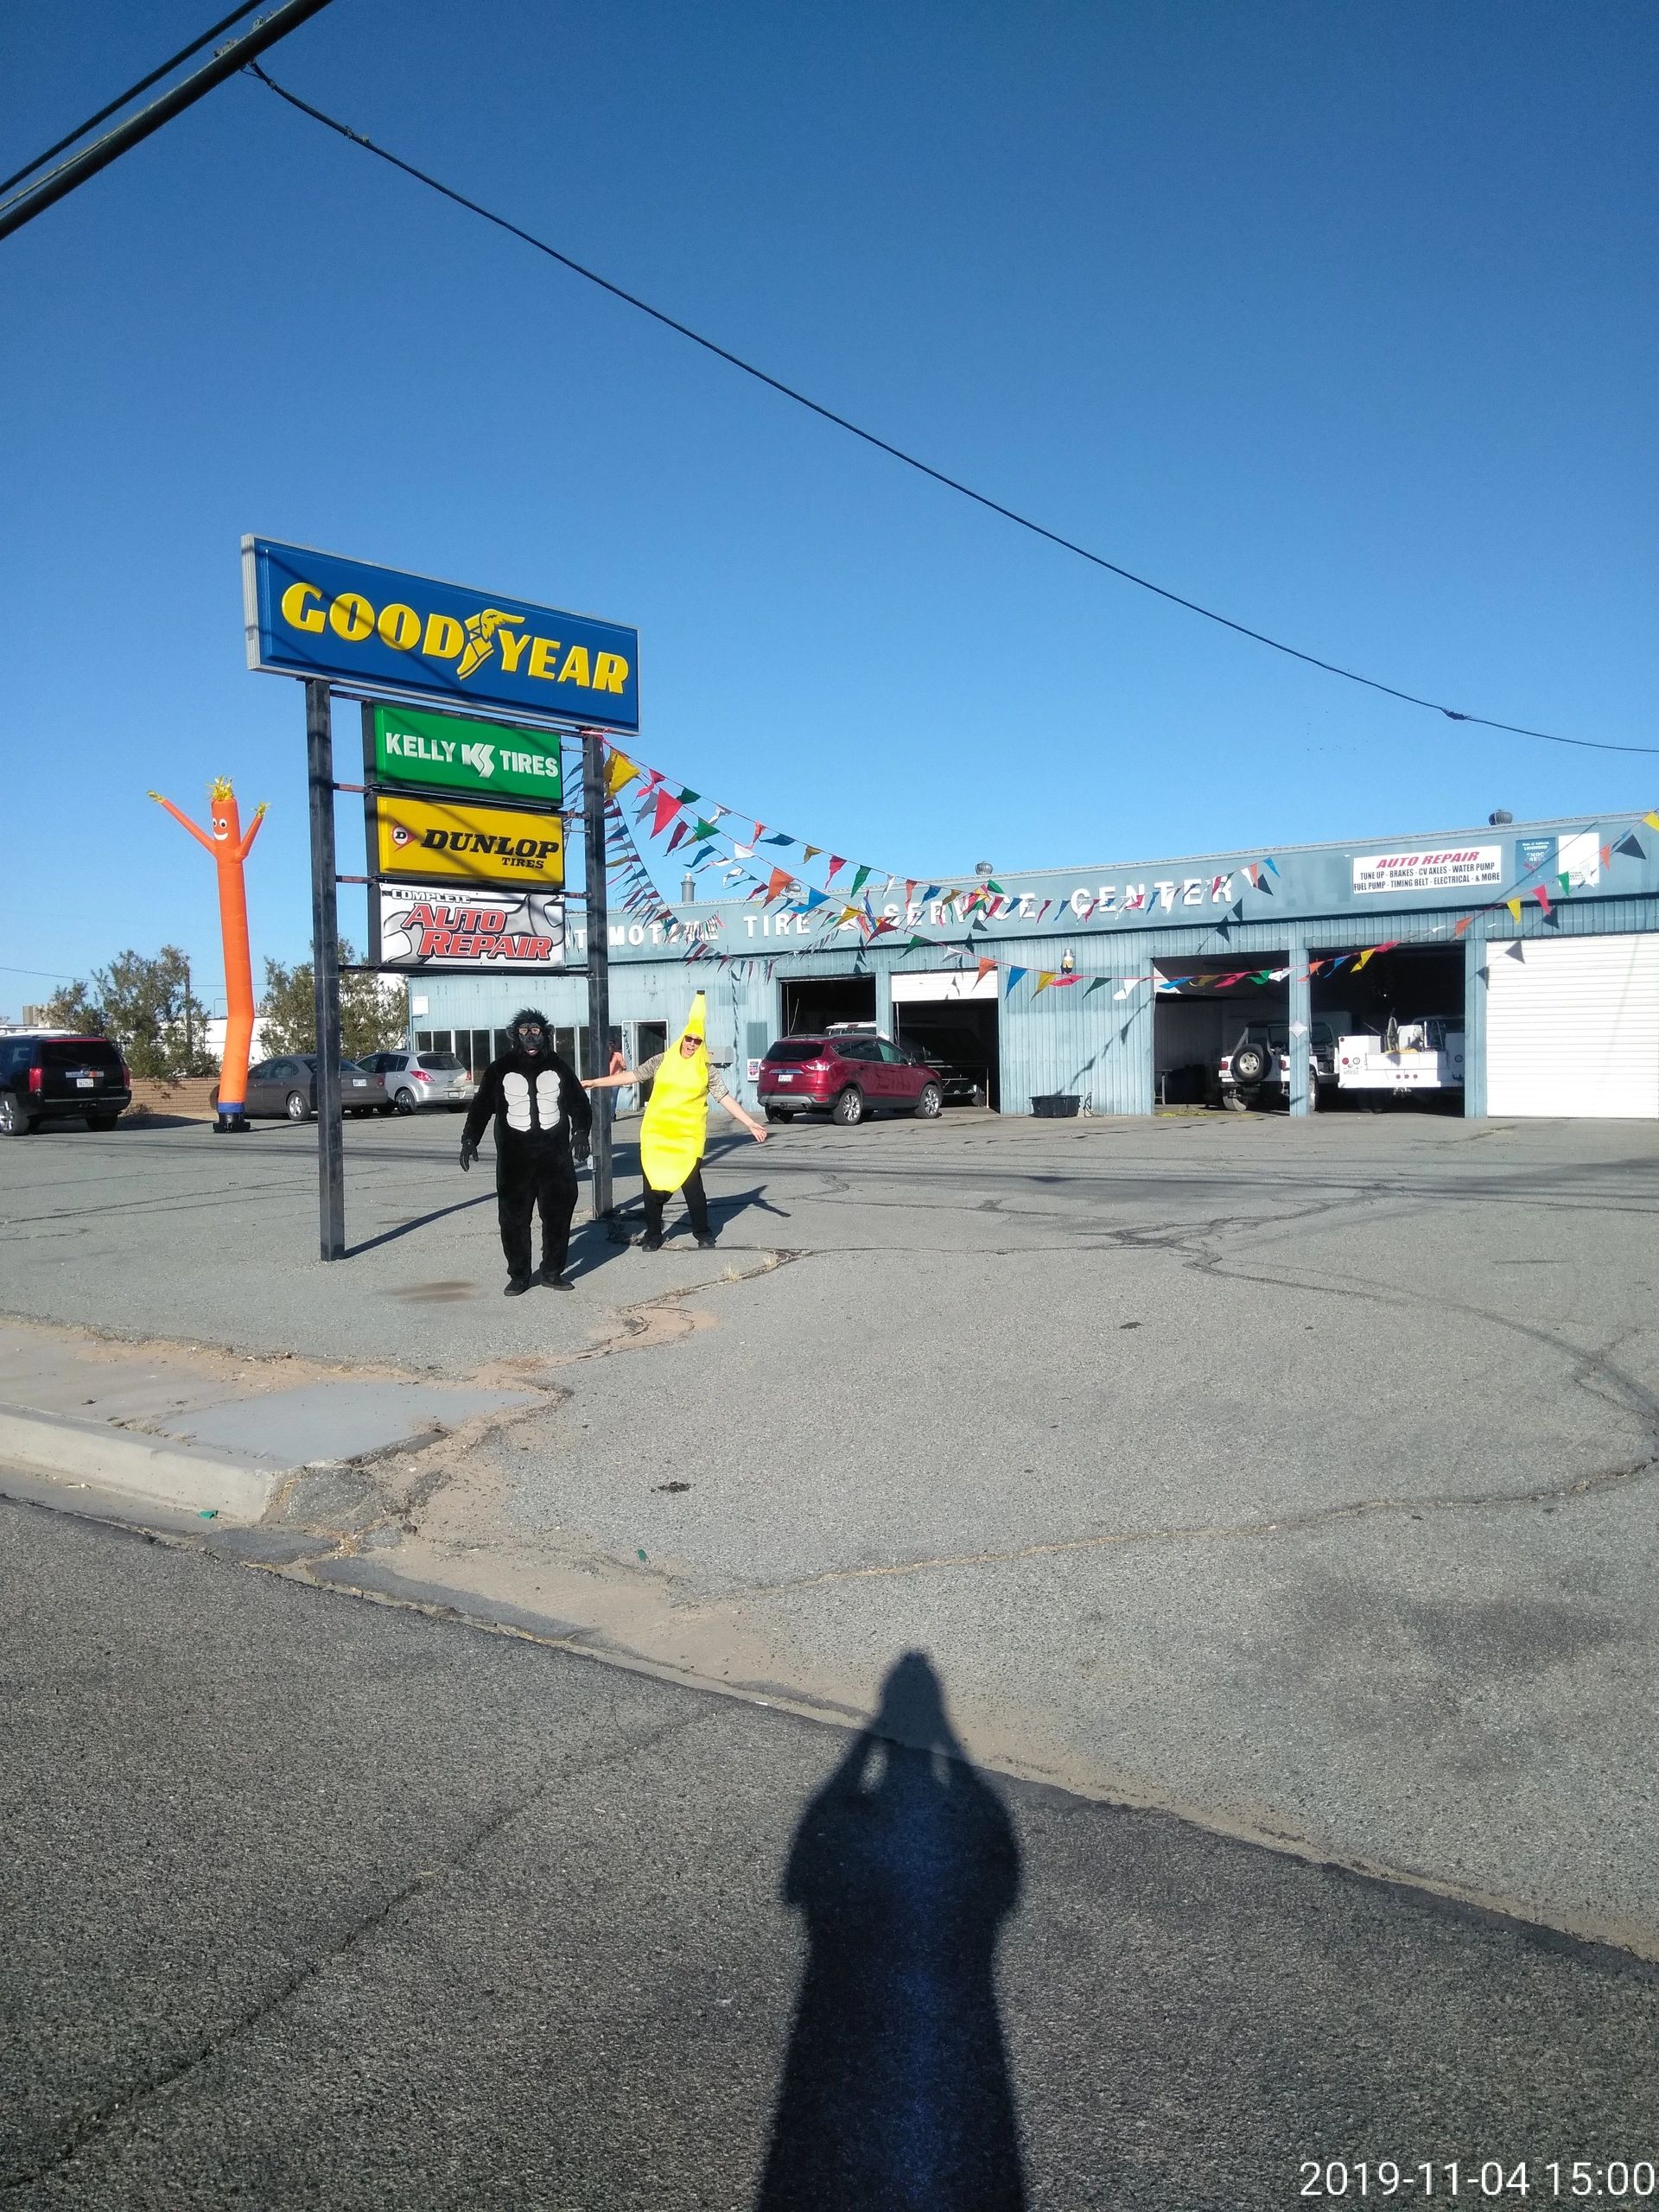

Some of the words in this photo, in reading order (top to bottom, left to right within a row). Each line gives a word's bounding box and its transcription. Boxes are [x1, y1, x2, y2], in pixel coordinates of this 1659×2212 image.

[386, 732, 456, 762] KELLY
[499, 750, 559, 778] TIRES
[420, 828, 559, 859] DUNLOP
[502, 857, 544, 869] TIRES
[1360, 872, 1376, 880] TUNE
[1376, 871, 1385, 880] UP
[1389, 868, 1414, 878] BRAKES
[1419, 867, 1427, 876] CV
[1428, 866, 1447, 875] AXLES
[1452, 863, 1474, 874] WATER
[1476, 861, 1495, 871] PUMP
[1376, 856, 1419, 868] AUTO
[1421, 851, 1479, 865] REPAIR
[1354, 882, 1367, 891] FUEL
[1368, 880, 1386, 890] PUMP
[1390, 878, 1413, 888] TIMING
[1414, 877, 1428, 887] BELT
[1433, 874, 1471, 885] ELECTRICAL
[1481, 872, 1500, 881] MORE
[391, 889, 471, 904] COMPLETE
[743, 912, 810, 938] TIRE
[1071, 876, 1232, 914] CENTER
[401, 903, 507, 932] AUTO
[417, 928, 553, 960] REPAIR
